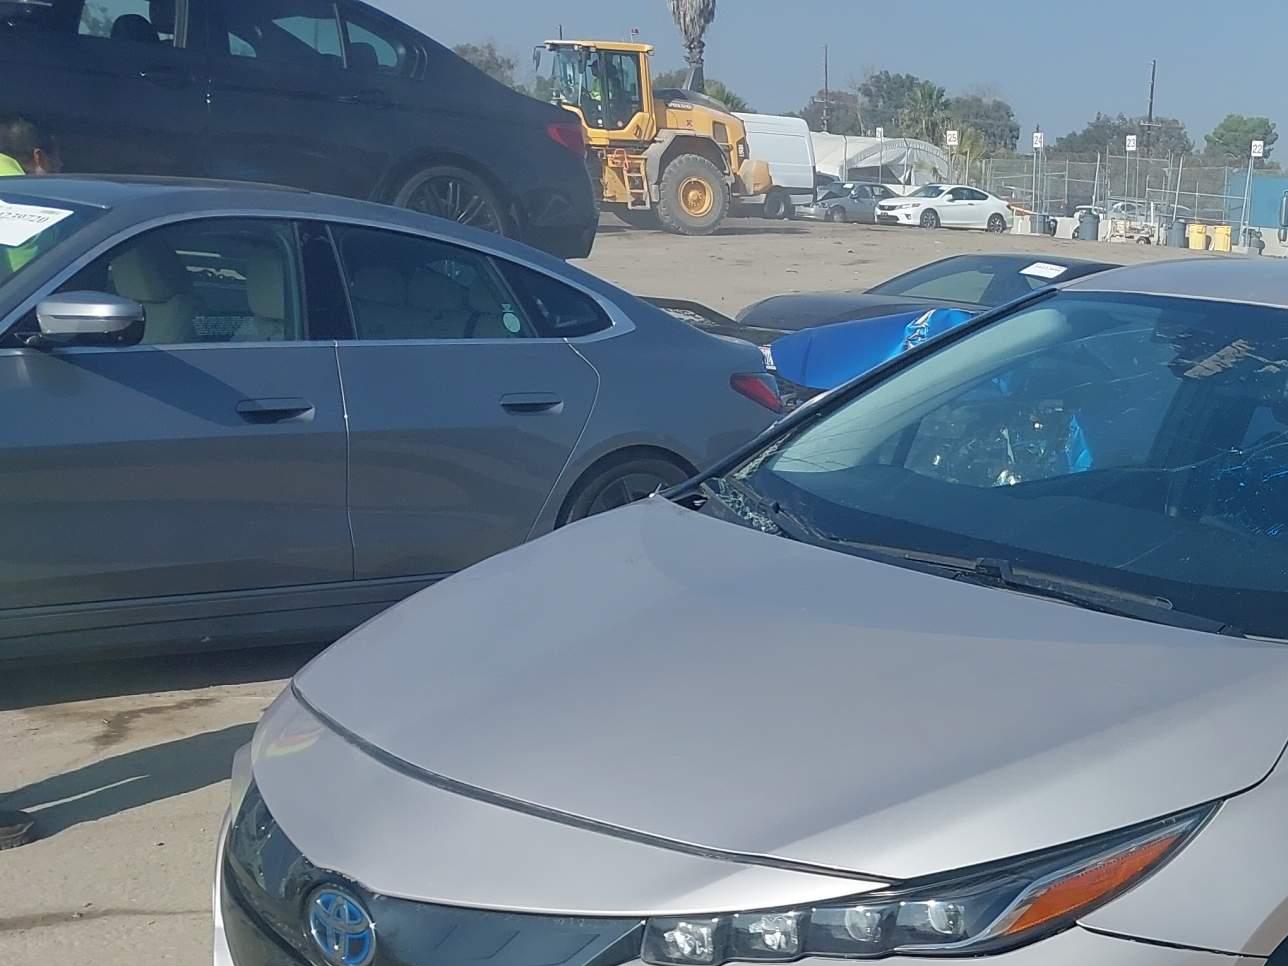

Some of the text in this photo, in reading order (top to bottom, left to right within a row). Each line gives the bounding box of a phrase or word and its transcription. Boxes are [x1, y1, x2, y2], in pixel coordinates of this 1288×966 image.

[948, 133, 957, 143] 25
[1127, 138, 1136, 148] 23
[1252, 144, 1262, 154] 22
